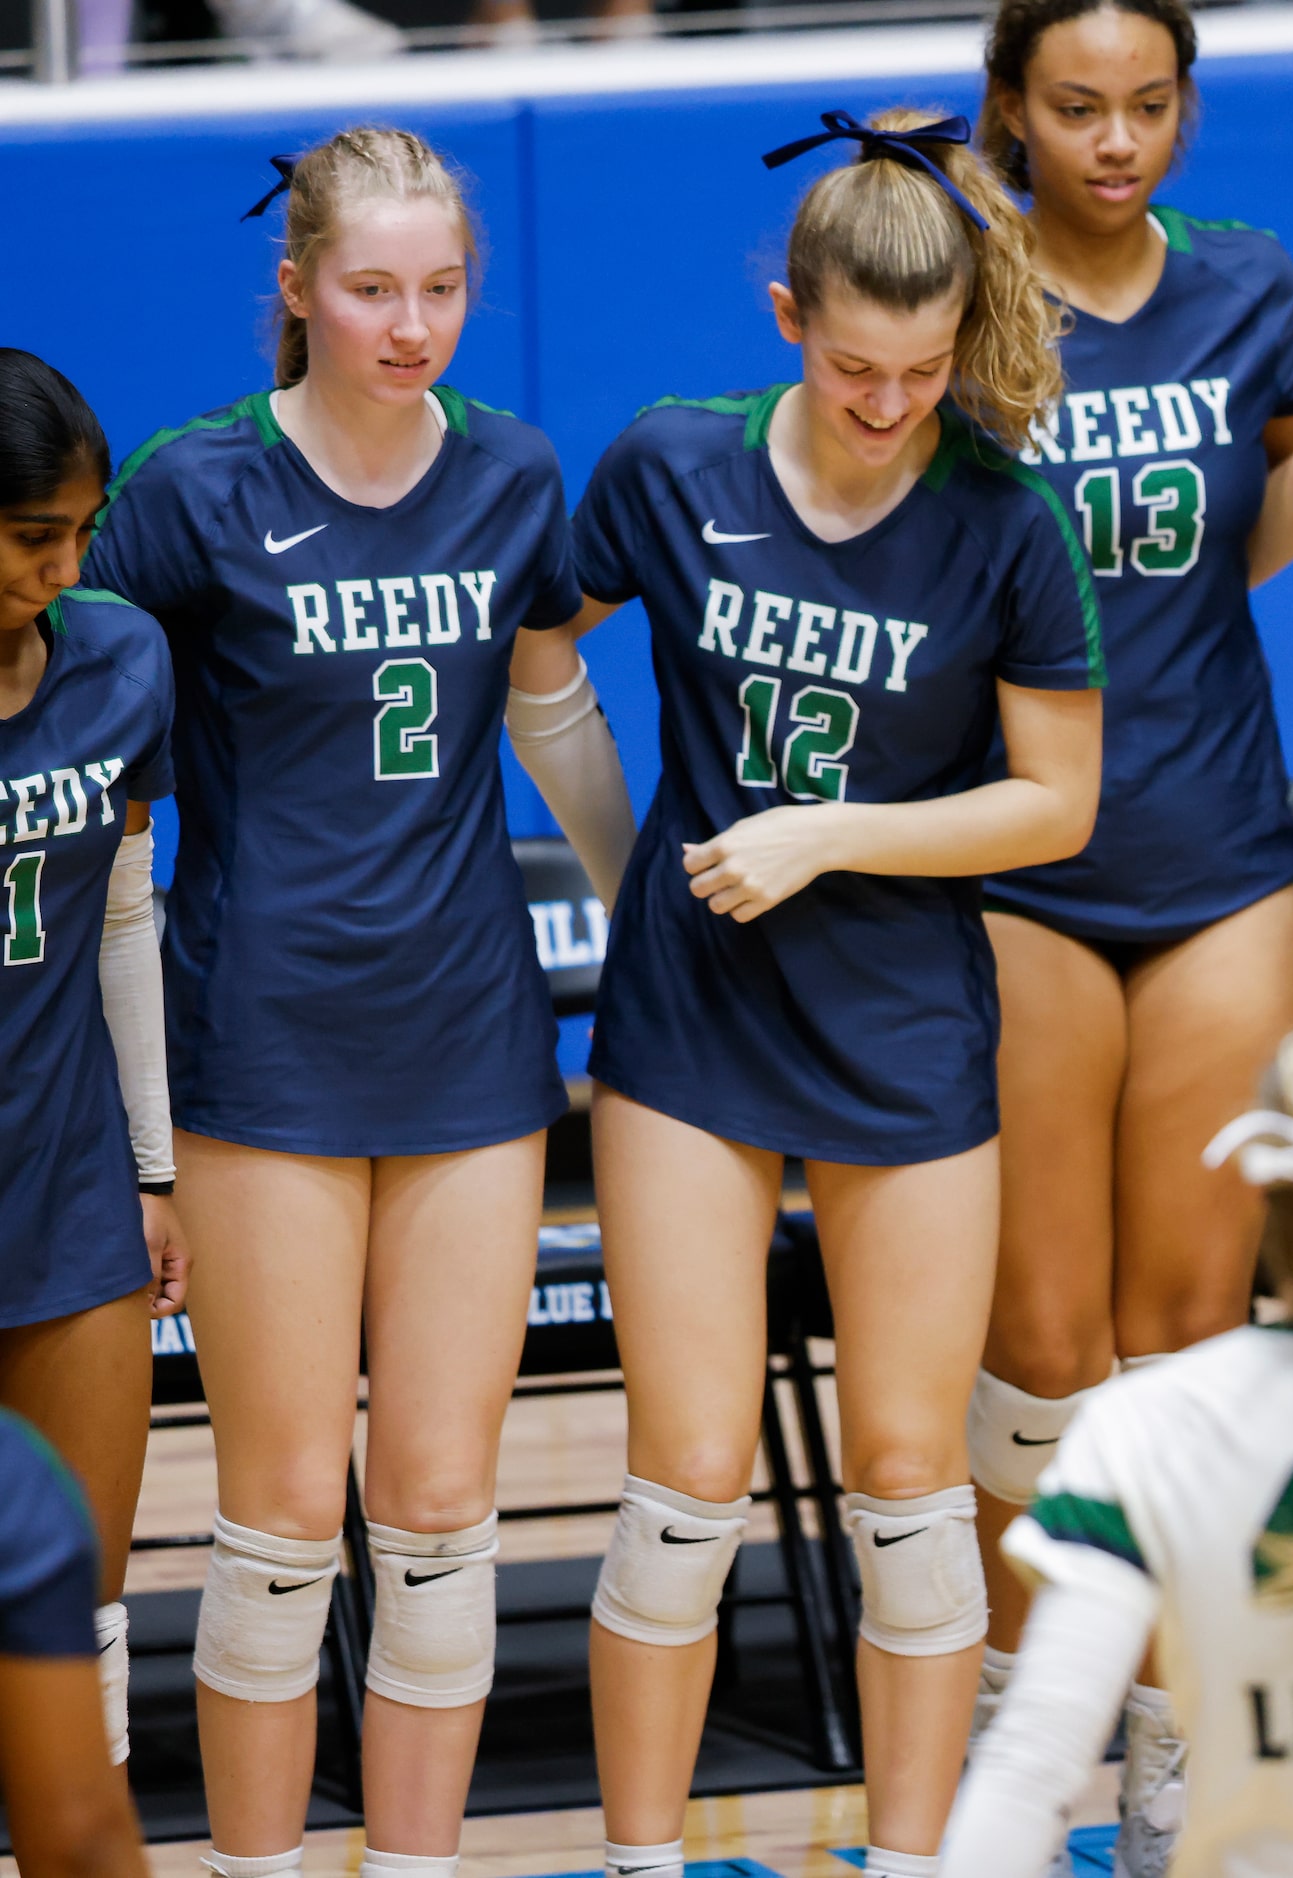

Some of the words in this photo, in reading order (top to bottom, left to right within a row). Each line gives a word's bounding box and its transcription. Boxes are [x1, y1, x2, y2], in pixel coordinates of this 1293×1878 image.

[1019, 377, 1233, 466] REEDY
[1074, 458, 1207, 578] 13
[287, 570, 498, 655] REEDY
[698, 577, 929, 693] REEDY
[372, 658, 441, 782] 2
[736, 673, 860, 803] 12
[0, 757, 125, 845] EDY
[3, 850, 46, 967] 1
